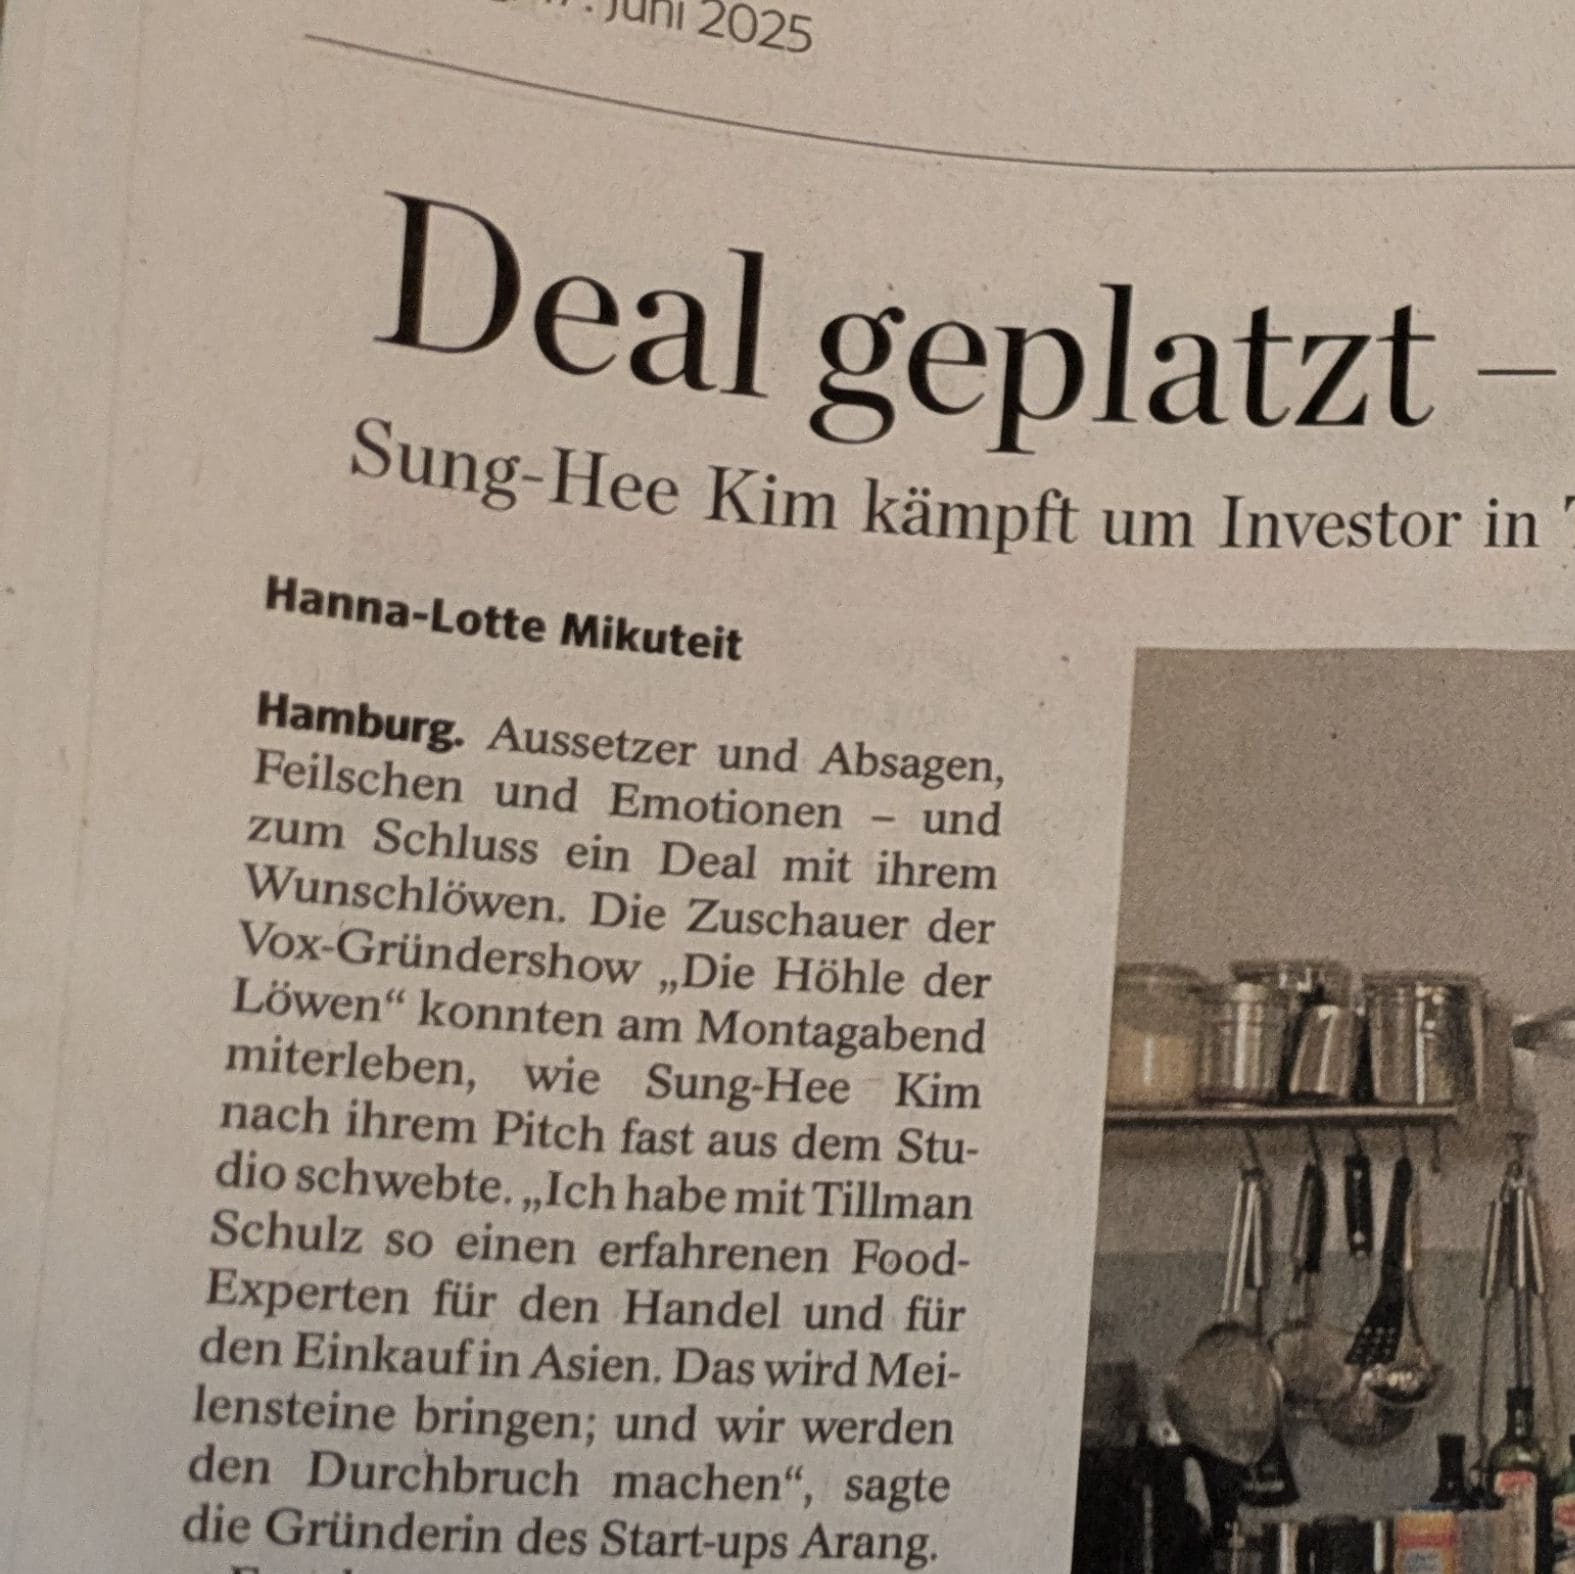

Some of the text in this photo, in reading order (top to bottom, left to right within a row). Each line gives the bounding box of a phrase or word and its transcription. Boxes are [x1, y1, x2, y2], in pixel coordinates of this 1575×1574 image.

[698, 0, 813, 53] 2025
[373, 191, 768, 399] Deal
[808, 282, 1436, 455] geplatzt
[351, 418, 679, 516] Sung-Hee
[705, 465, 836, 530] Kim
[863, 477, 1079, 555] kämpft
[1102, 509, 1193, 548] um
[1219, 495, 1462, 549] Investor
[1484, 497, 1538, 548] in
[265, 574, 743, 662] Hanna-Lotte Mikuteit
[256, 690, 1004, 791] Hamburg. Aussetzer und Absagen,
[239, 919, 642, 985] Vox-Gründershow
[774, 956, 905, 997] Höhle
[923, 961, 992, 1000] der
[205, 1267, 967, 1333] Experten für den Handel und für
